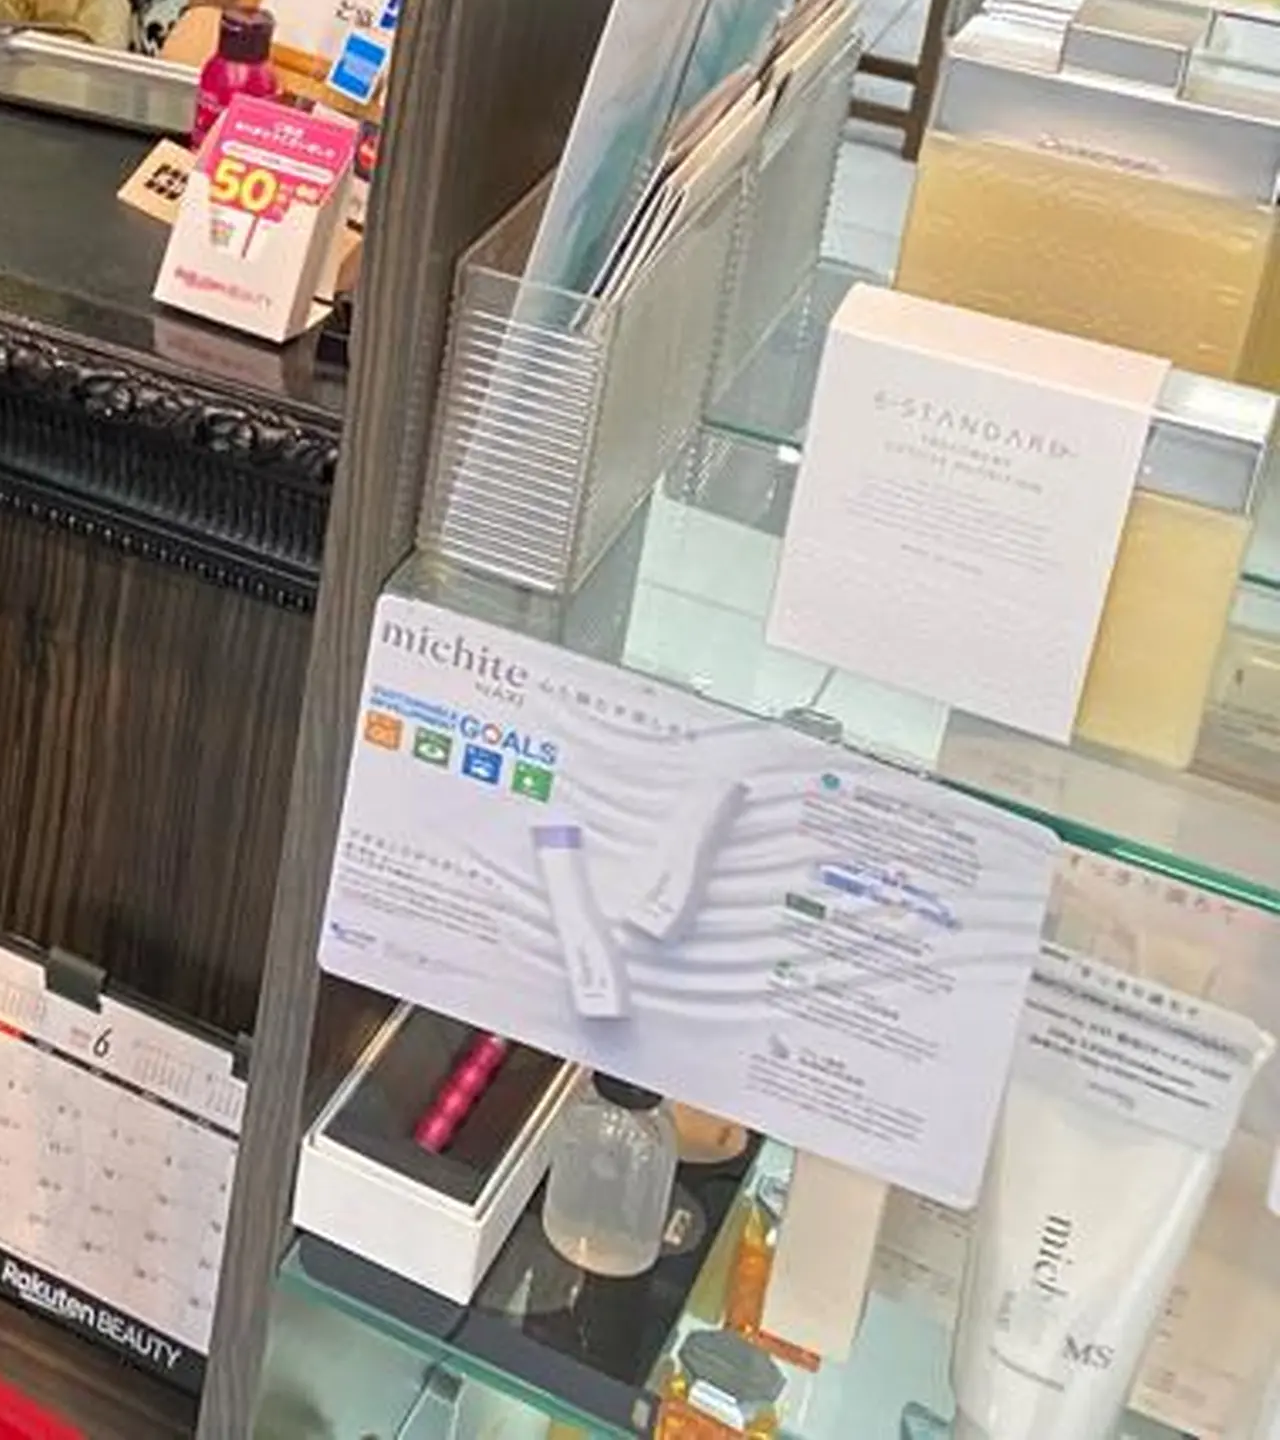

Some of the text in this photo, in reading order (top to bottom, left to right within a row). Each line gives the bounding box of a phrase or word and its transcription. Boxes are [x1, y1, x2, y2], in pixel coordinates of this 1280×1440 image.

[211, 155, 276, 214] 50
[380, 619, 530, 688] michite
[459, 714, 560, 766] GOALS
[93, 1026, 112, 1058] 6
[1, 1259, 182, 1368] Rakuten BEAUTY
[1060, 1333, 1117, 1372] MS
